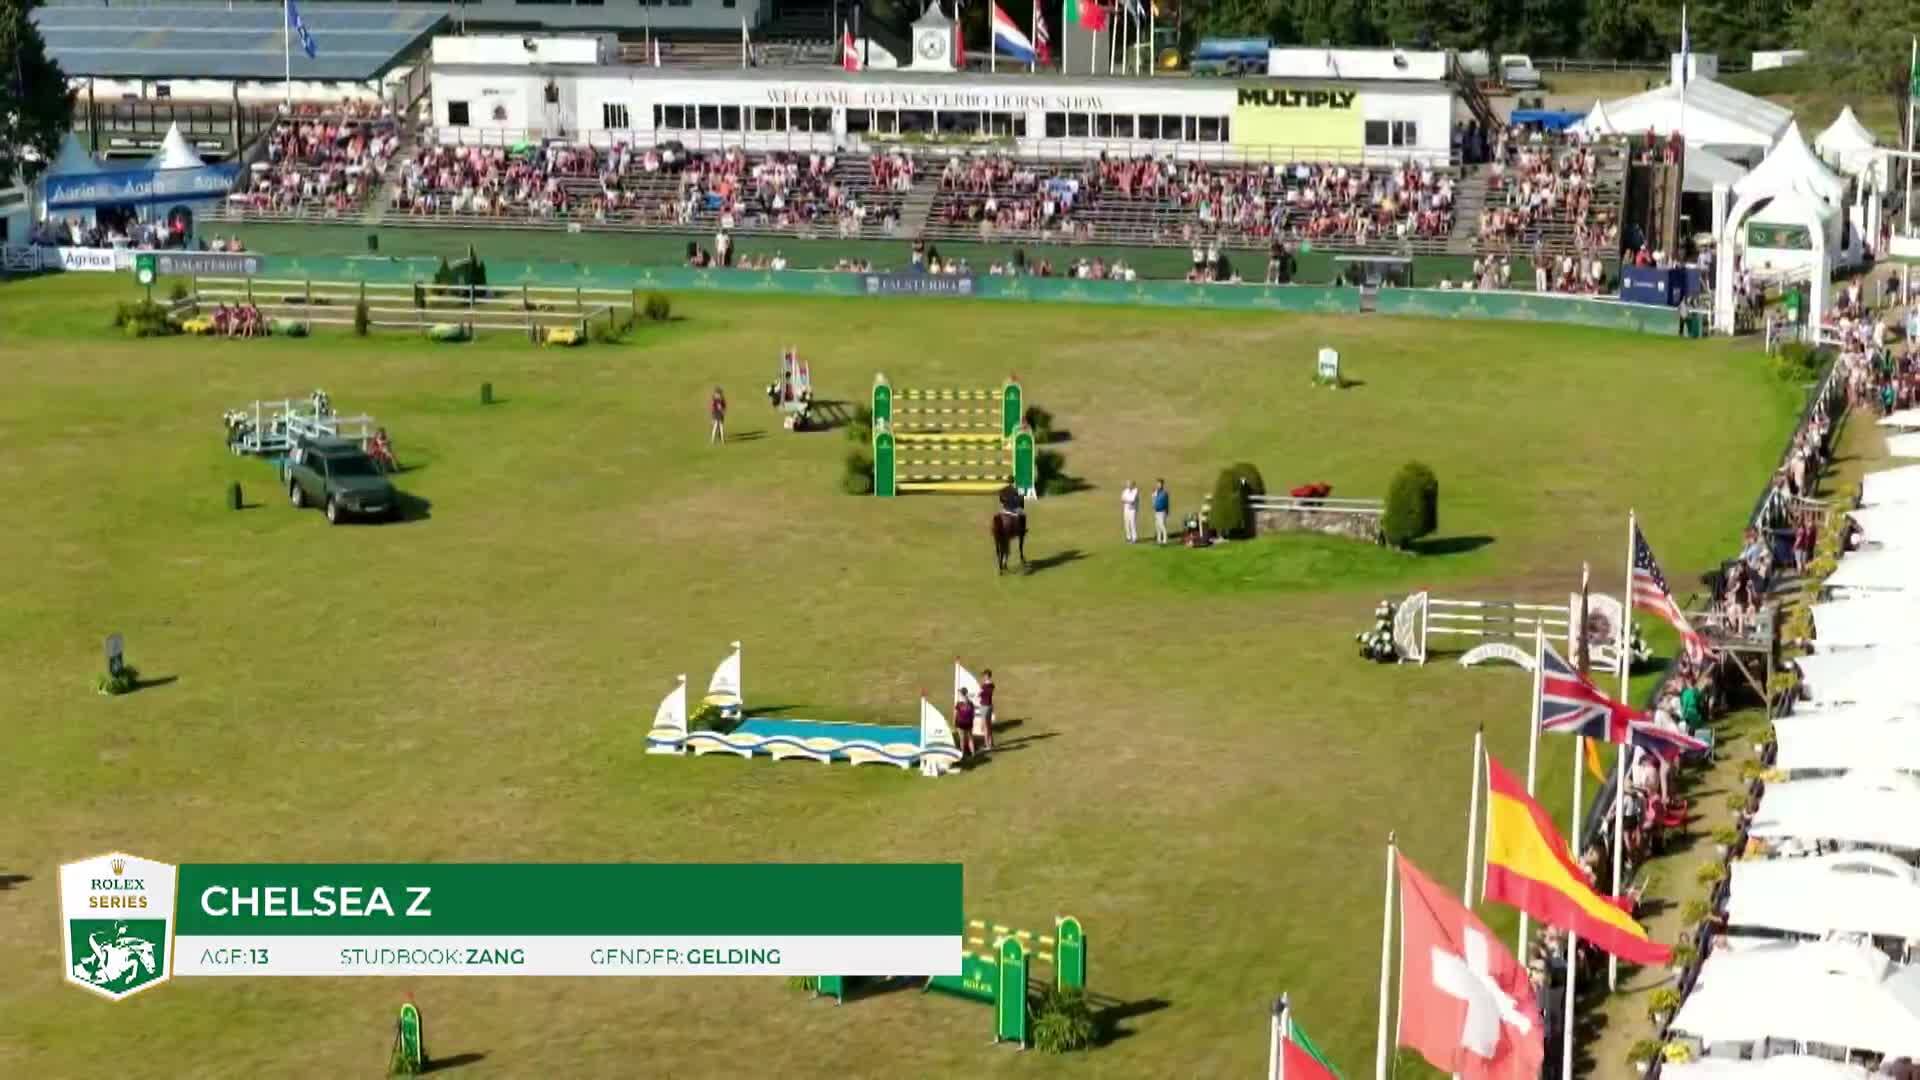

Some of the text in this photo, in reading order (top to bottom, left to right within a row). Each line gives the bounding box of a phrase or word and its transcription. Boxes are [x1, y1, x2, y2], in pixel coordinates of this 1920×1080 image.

[767, 87, 1104, 109] WELCOME TO FALSTERBO HORSE SHOW
[1237, 88, 1356, 109] MULTIPLY
